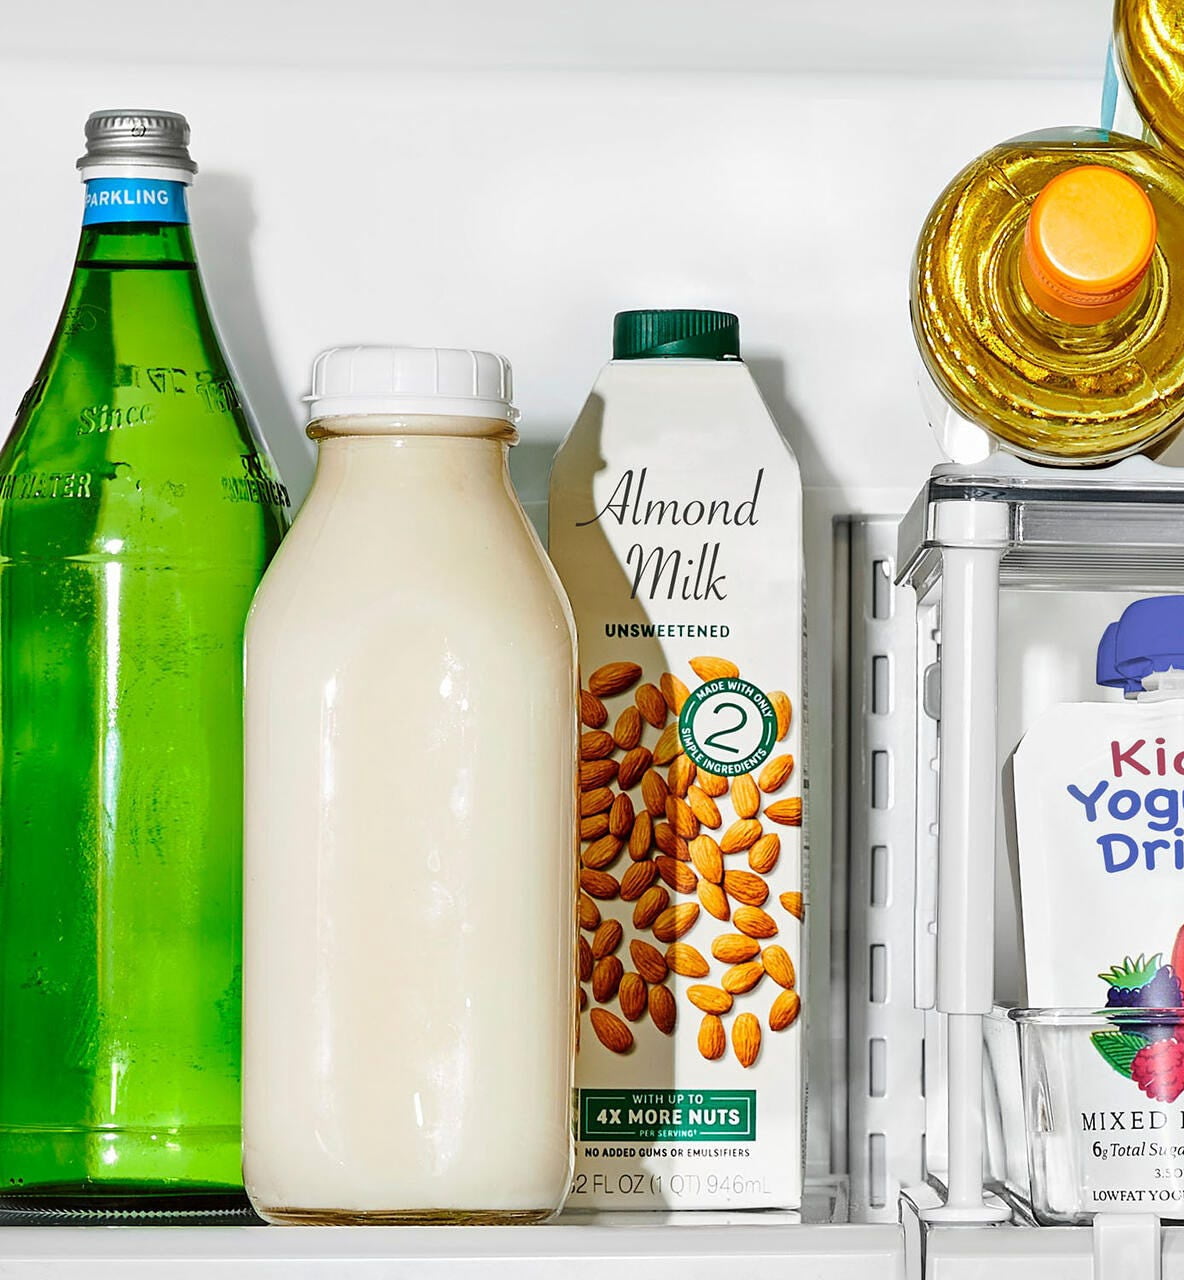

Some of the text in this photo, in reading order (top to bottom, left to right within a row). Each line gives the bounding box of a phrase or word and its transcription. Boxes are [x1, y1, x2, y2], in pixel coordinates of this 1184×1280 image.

[85, 189, 169, 207] PARKLING
[575, 468, 765, 527] Almond
[626, 542, 728, 601] Milk
[605, 623, 731, 638] UNSWEETENED
[696, 681, 773, 718] MADE WITH ONLY
[703, 702, 748, 754] 2
[681, 727, 767, 774] SIMPLE INGREDIENTS
[632, 1094, 703, 1104] WITH UP TO
[596, 1108, 740, 1125] 4X MORE NUTS
[1081, 1111, 1168, 1131] MIXED
[639, 1129, 655, 1137] PER
[585, 1148, 750, 1157] NO ADDED GUMS OR EMULSIFIERS
[1092, 1141, 1108, 1160] 6g
[1110, 1142, 1146, 1157] Total
[1154, 1169, 1171, 1179] 3.5
[593, 1174, 614, 1193] FL
[618, 1174, 644, 1194] OZ
[670, 1174, 700, 1197] QT)
[707, 1174, 772, 1194] 946mL
[1092, 1190, 1146, 1202] LOWFAT
